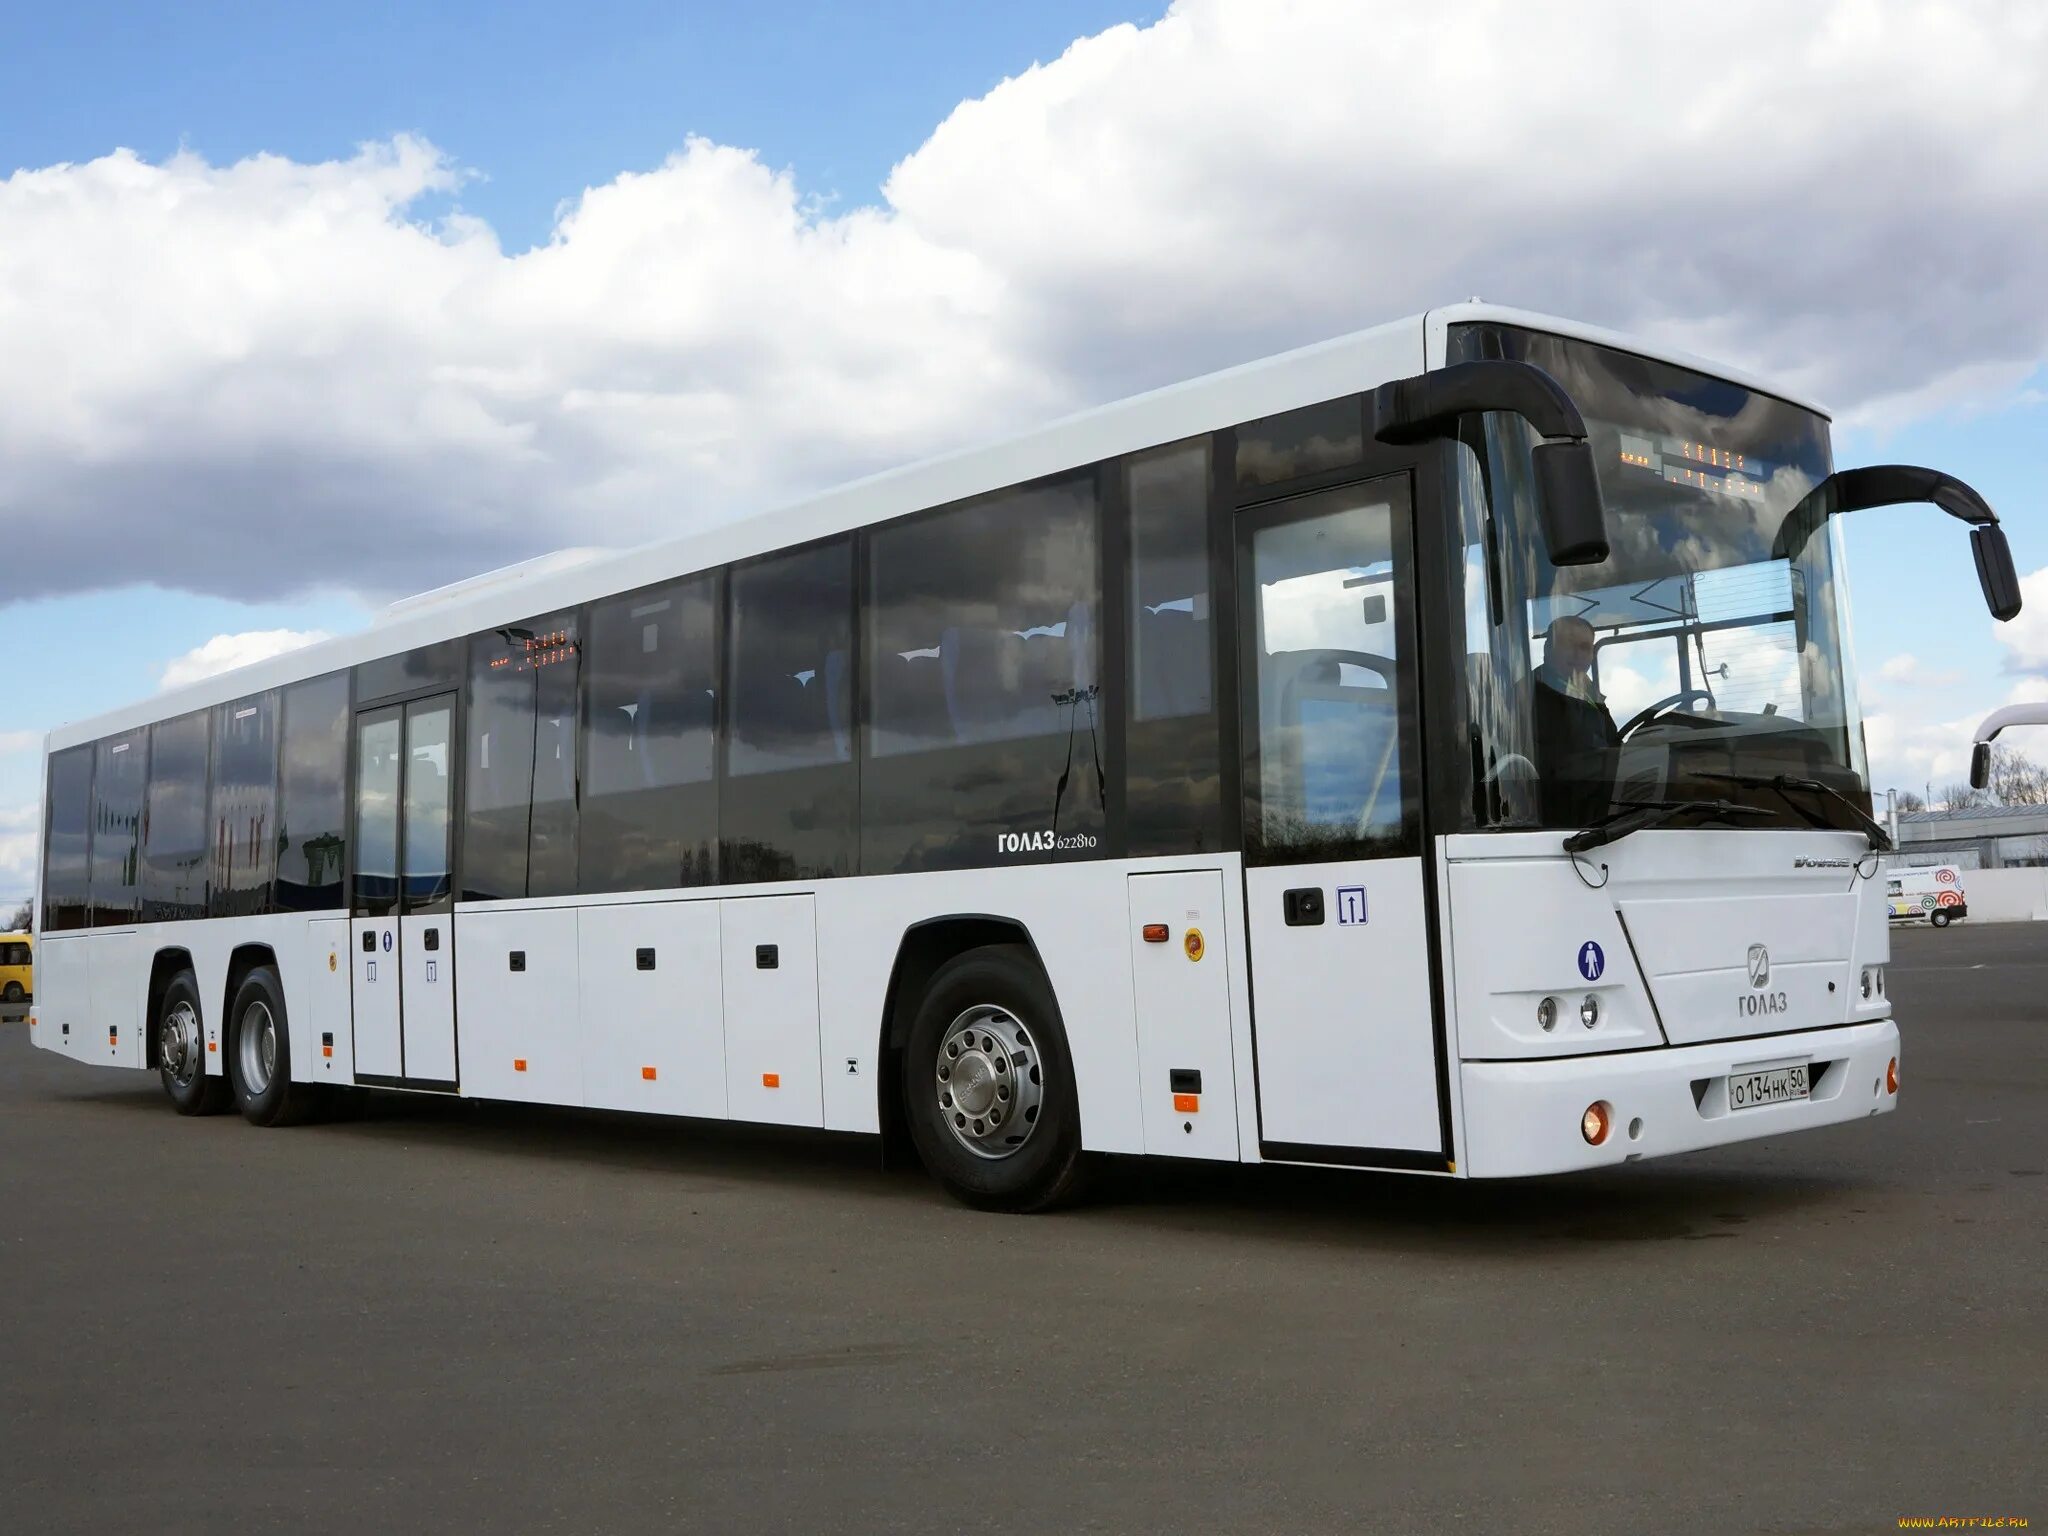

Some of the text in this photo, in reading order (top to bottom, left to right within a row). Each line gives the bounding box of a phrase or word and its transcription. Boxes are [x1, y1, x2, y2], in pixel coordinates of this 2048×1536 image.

[998, 830, 1097, 853] ГОЛАЗ 622810
[1738, 991, 1788, 1018] ГОЛАЗ
[1790, 1069, 1804, 1088] 50
